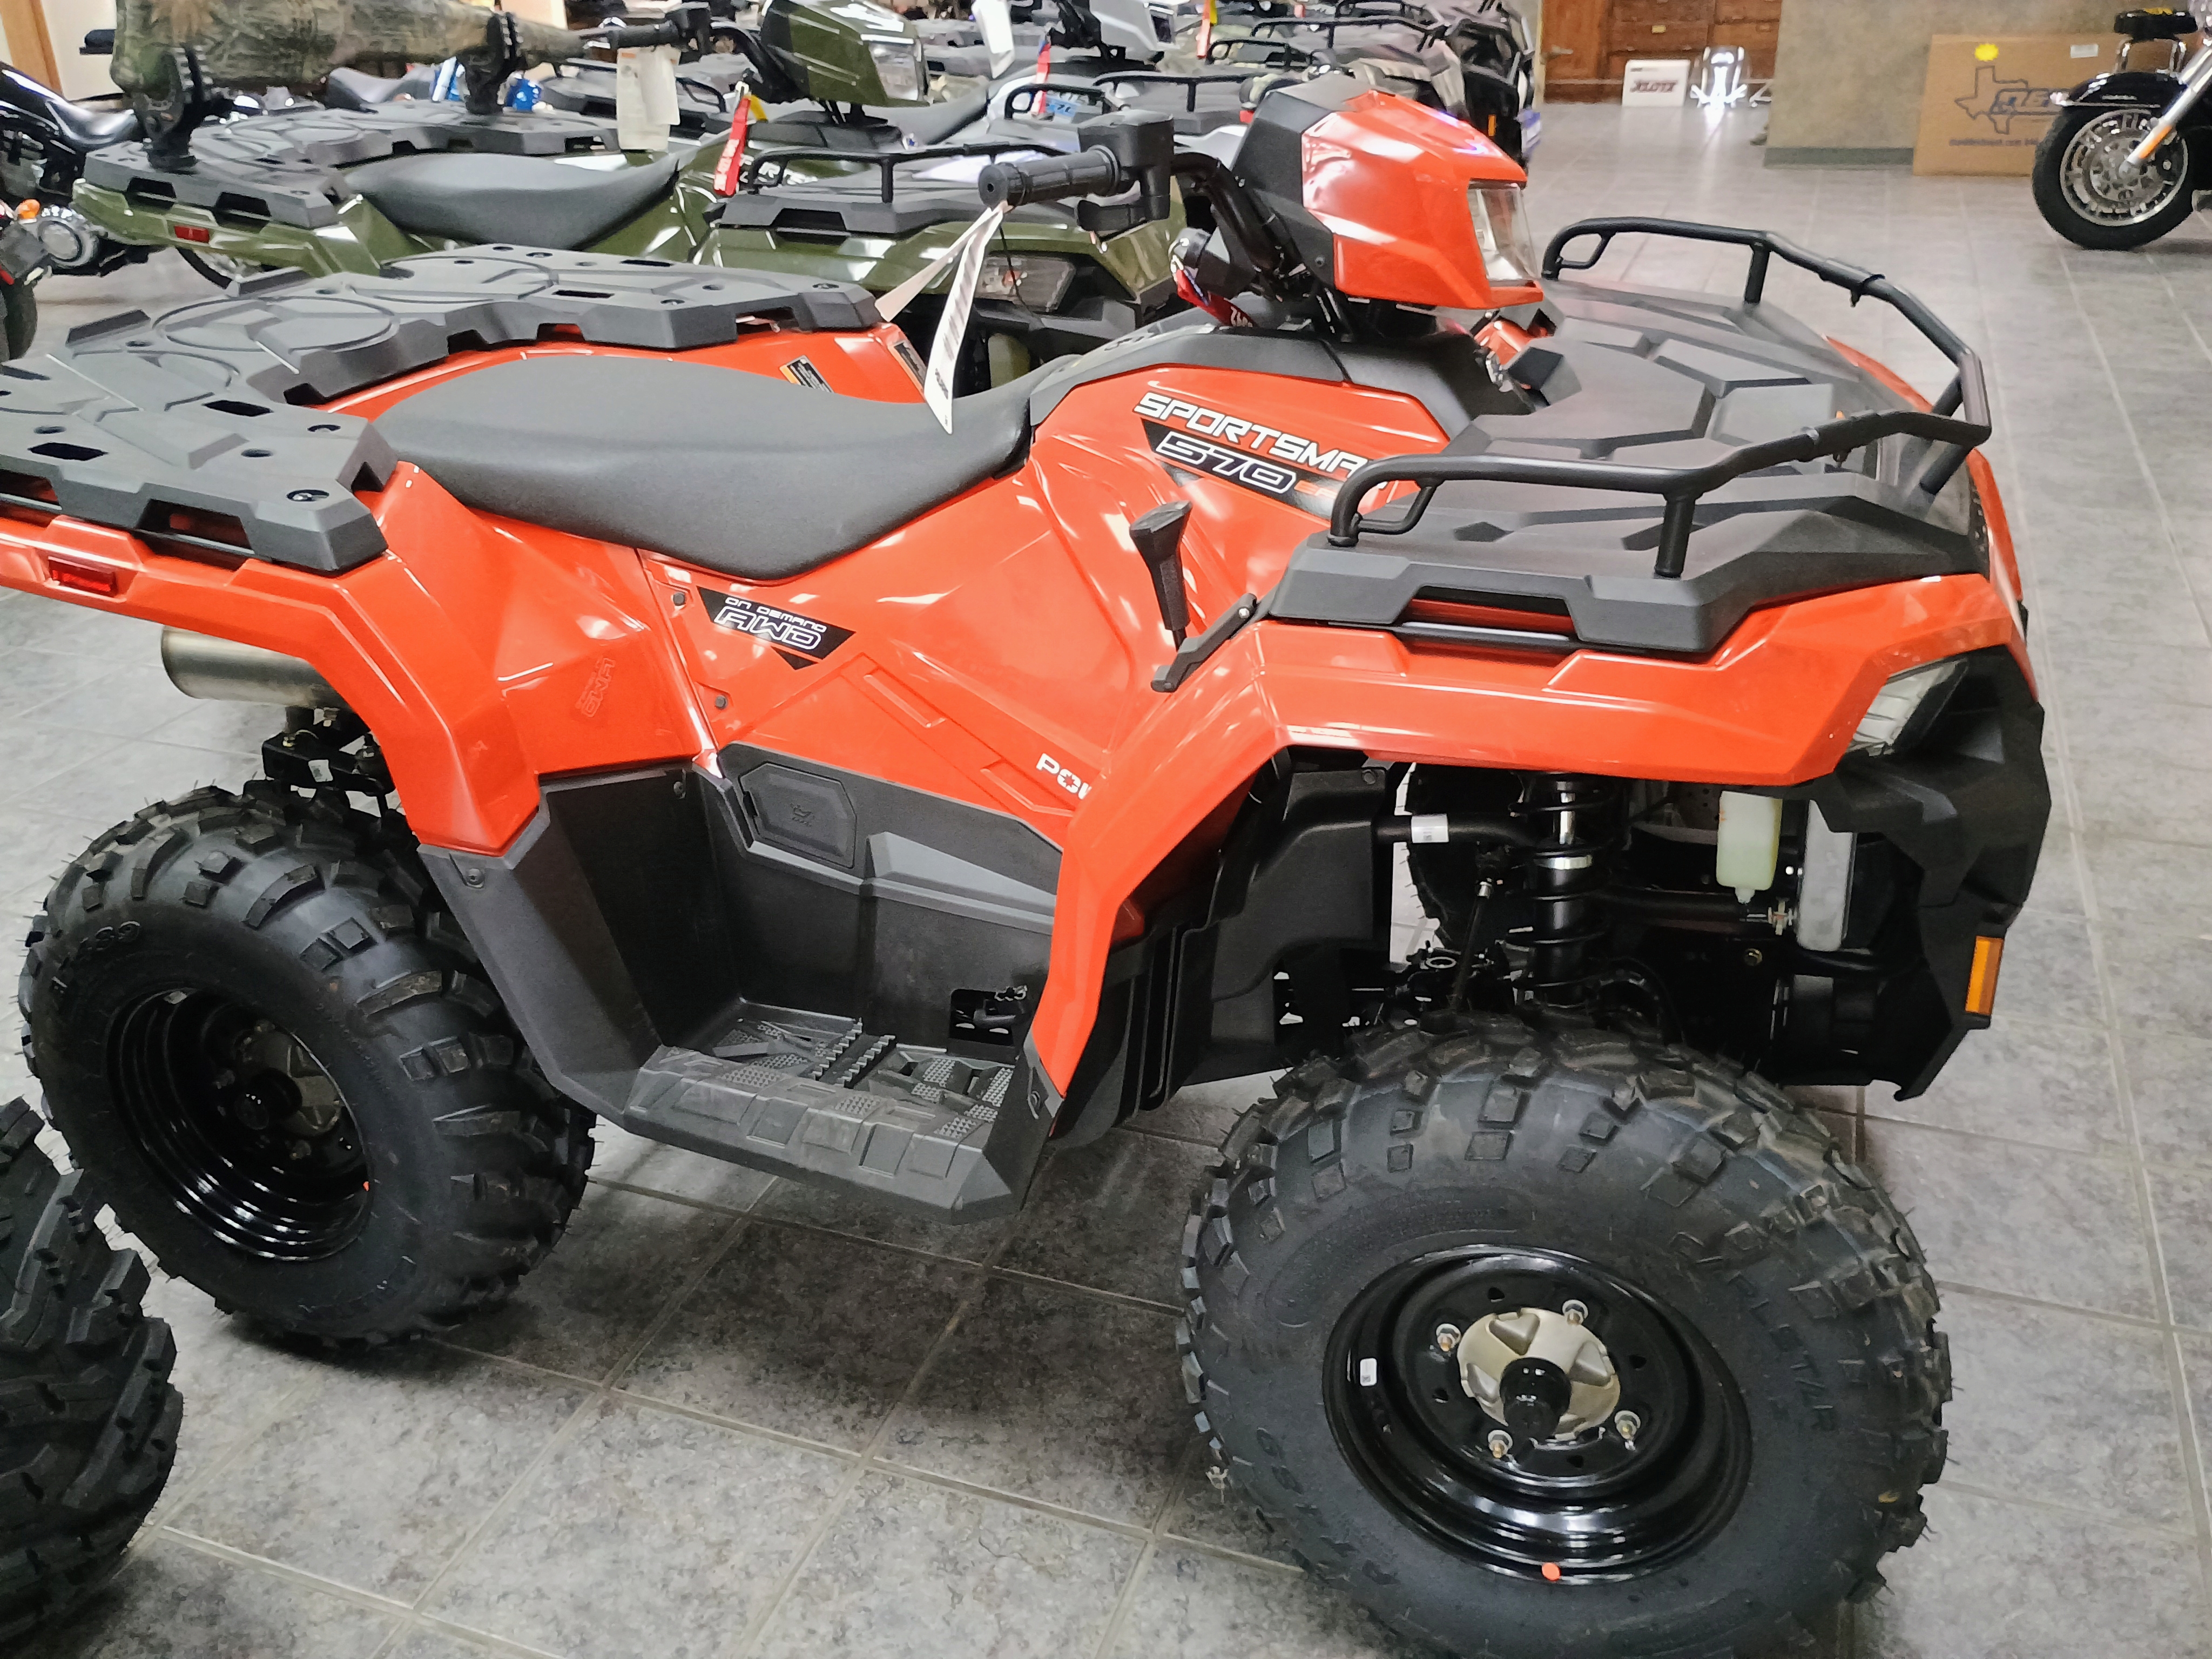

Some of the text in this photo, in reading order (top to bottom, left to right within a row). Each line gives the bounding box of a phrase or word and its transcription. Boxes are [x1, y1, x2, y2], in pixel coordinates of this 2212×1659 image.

[1134, 392, 1370, 479] SPORTSMA
[1155, 431, 1297, 494] 570
[713, 606, 822, 651] AWD
[725, 597, 827, 633] ON DEMAND
